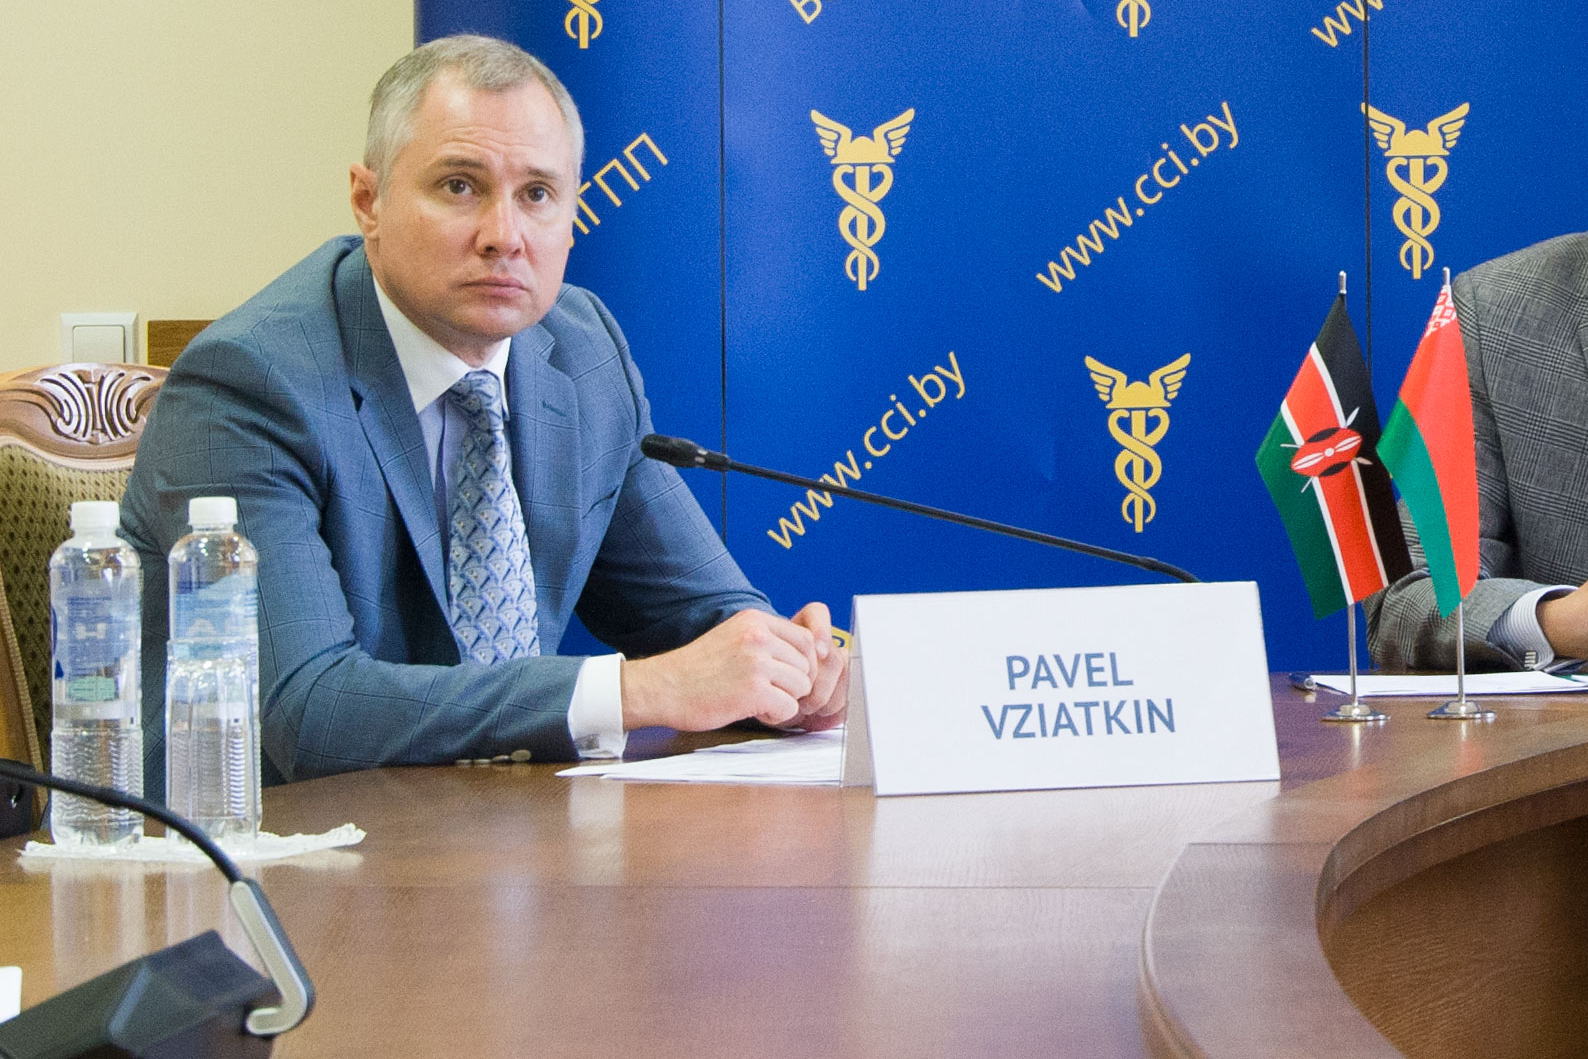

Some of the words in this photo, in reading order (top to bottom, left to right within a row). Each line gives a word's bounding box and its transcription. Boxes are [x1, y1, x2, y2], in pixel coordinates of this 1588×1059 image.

[1035, 100, 1240, 294] www.cci.by
[766, 350, 967, 550] www.cci.by
[980, 698, 1176, 740] VZIATKIN
[1006, 652, 1134, 690] PAVEL
